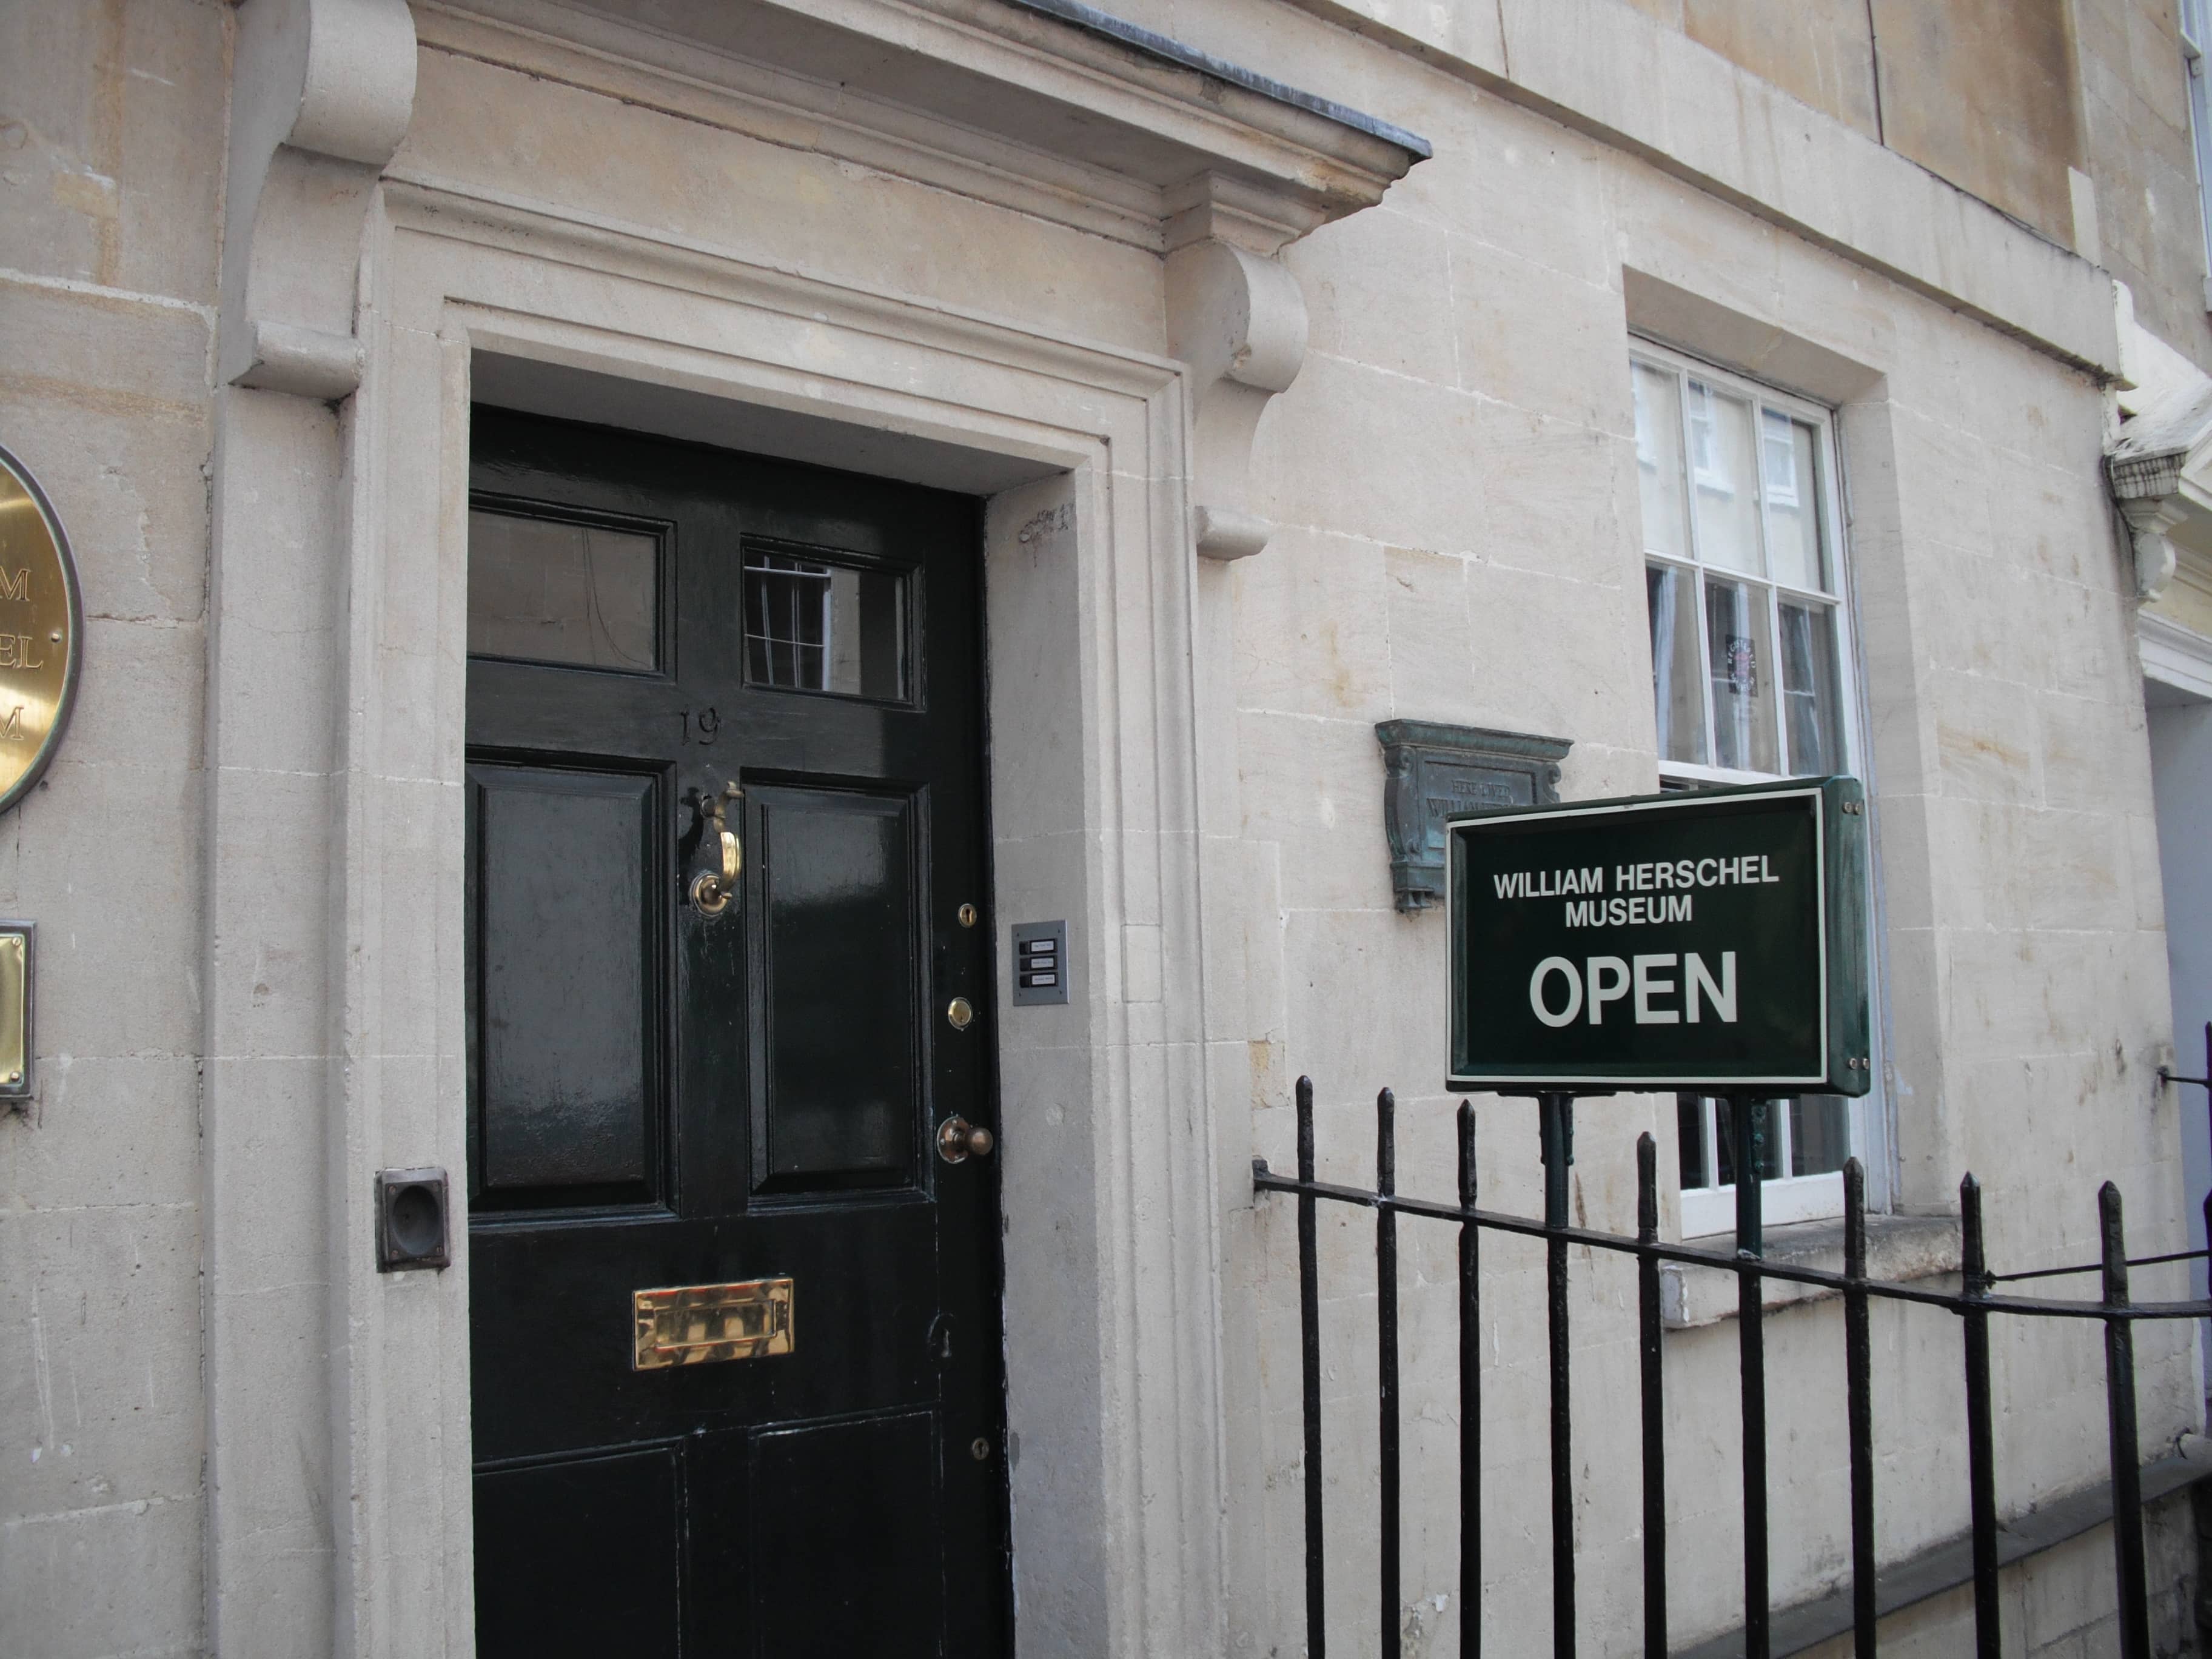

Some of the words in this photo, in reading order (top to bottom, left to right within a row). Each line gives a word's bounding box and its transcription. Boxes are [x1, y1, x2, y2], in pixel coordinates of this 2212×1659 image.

[680, 706, 722, 746] 19
[1493, 867, 1603, 899] WILLIAM
[1616, 855, 1780, 891] HERSCHEL
[1566, 894, 1692, 928] MUSEUM
[1529, 951, 1737, 1027] OPEN
